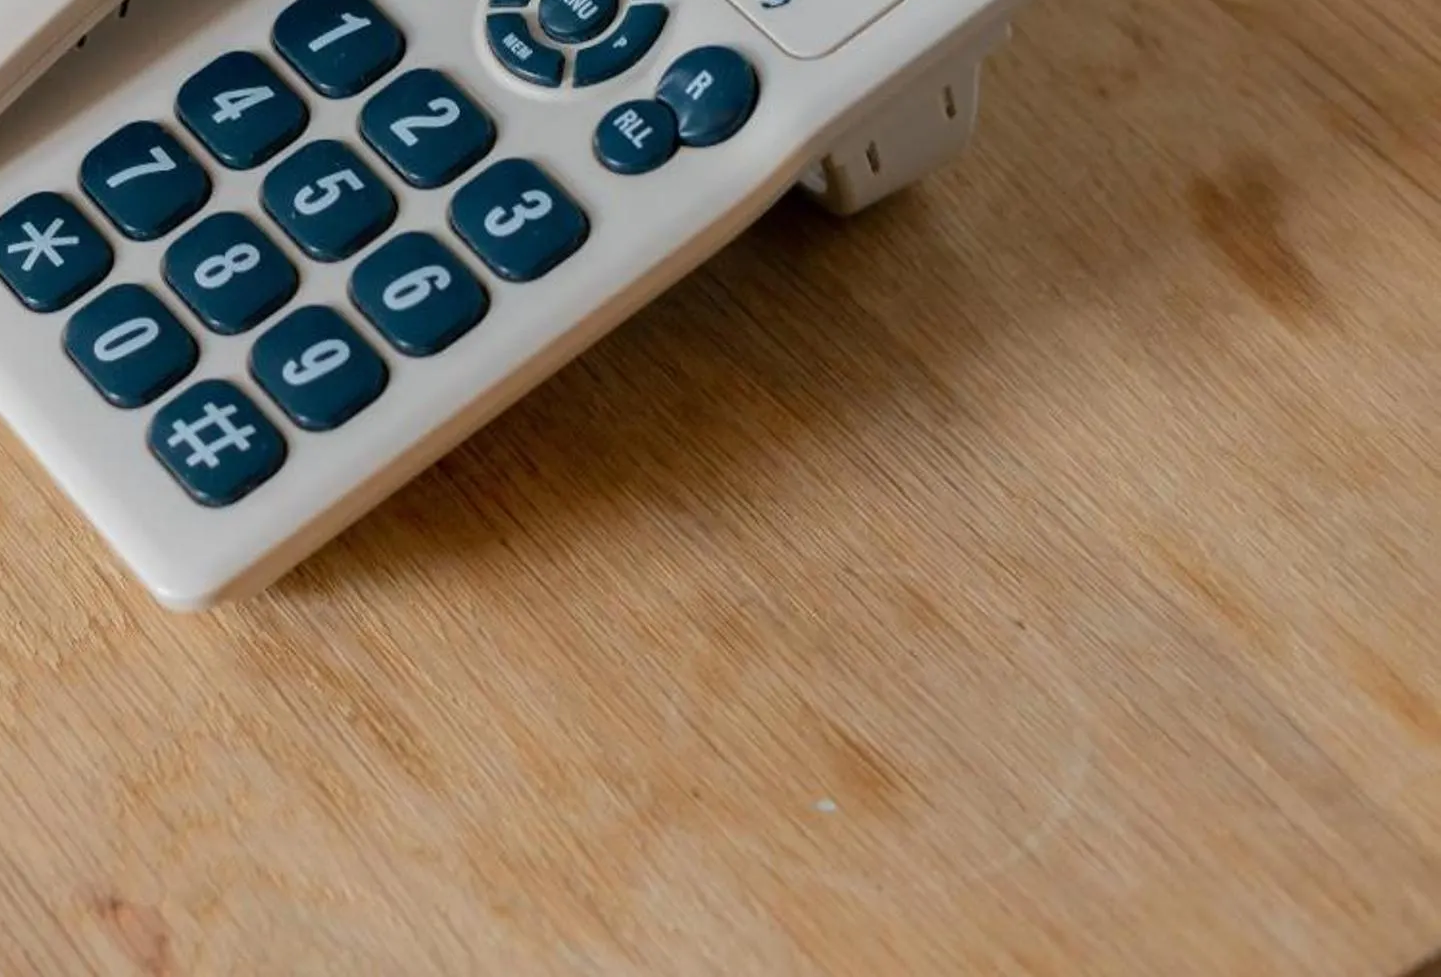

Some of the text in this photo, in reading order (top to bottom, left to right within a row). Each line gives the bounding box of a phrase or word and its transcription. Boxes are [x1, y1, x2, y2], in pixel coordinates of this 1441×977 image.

[308, 12, 371, 52] 1
[502, 32, 533, 61] MEM
[612, 36, 628, 49] P
[212, 86, 274, 124] 4
[684, 70, 713, 101] R
[390, 97, 461, 147] 2
[613, 109, 653, 149] RLL
[106, 146, 177, 188] 7
[293, 169, 364, 215] 5
[484, 190, 552, 237] 3
[193, 243, 260, 289] 8
[382, 265, 451, 310] 6
[93, 317, 159, 362] 0
[282, 339, 350, 386] 9
[167, 402, 256, 468] #
